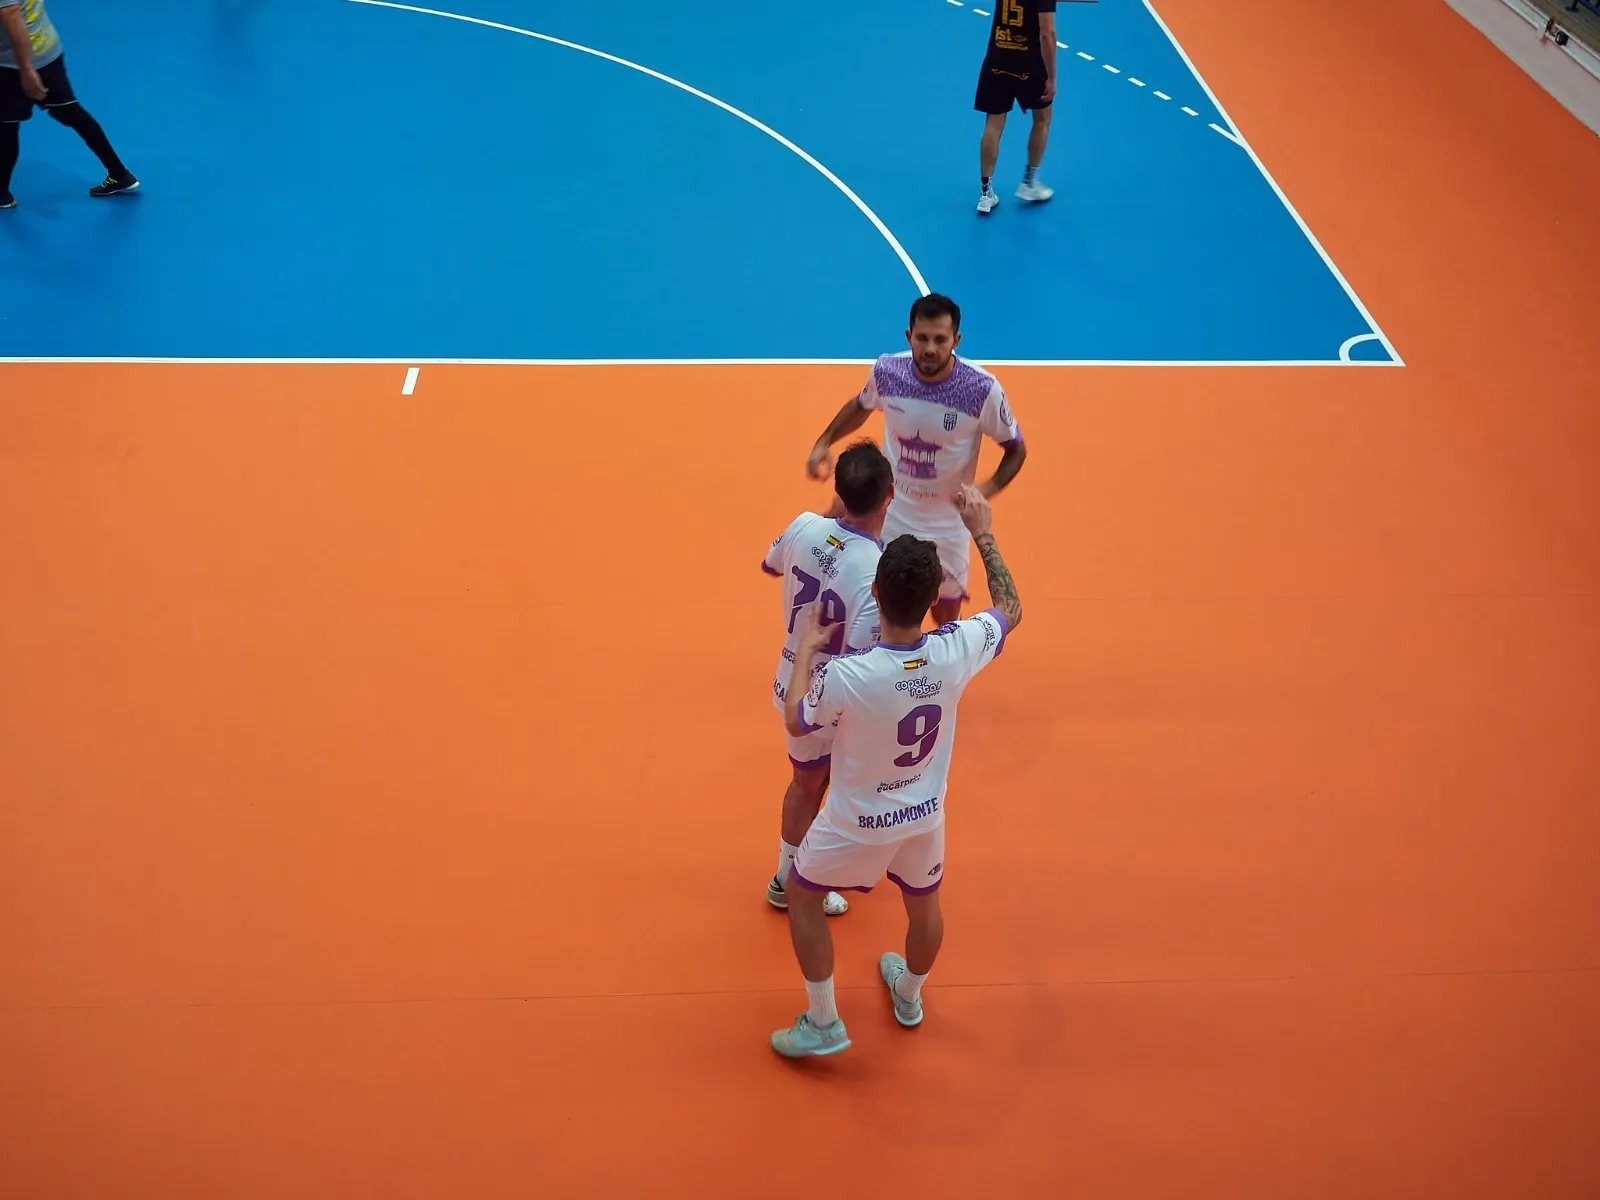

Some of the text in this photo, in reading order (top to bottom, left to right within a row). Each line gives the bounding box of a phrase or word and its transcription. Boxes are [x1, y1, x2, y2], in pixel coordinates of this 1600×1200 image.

[1002, 0, 1024, 27] 15
[895, 677, 927, 691] copas
[910, 681, 942, 697] rotas
[893, 704, 942, 767] 9
[858, 797, 938, 829] BRACAMONTE
